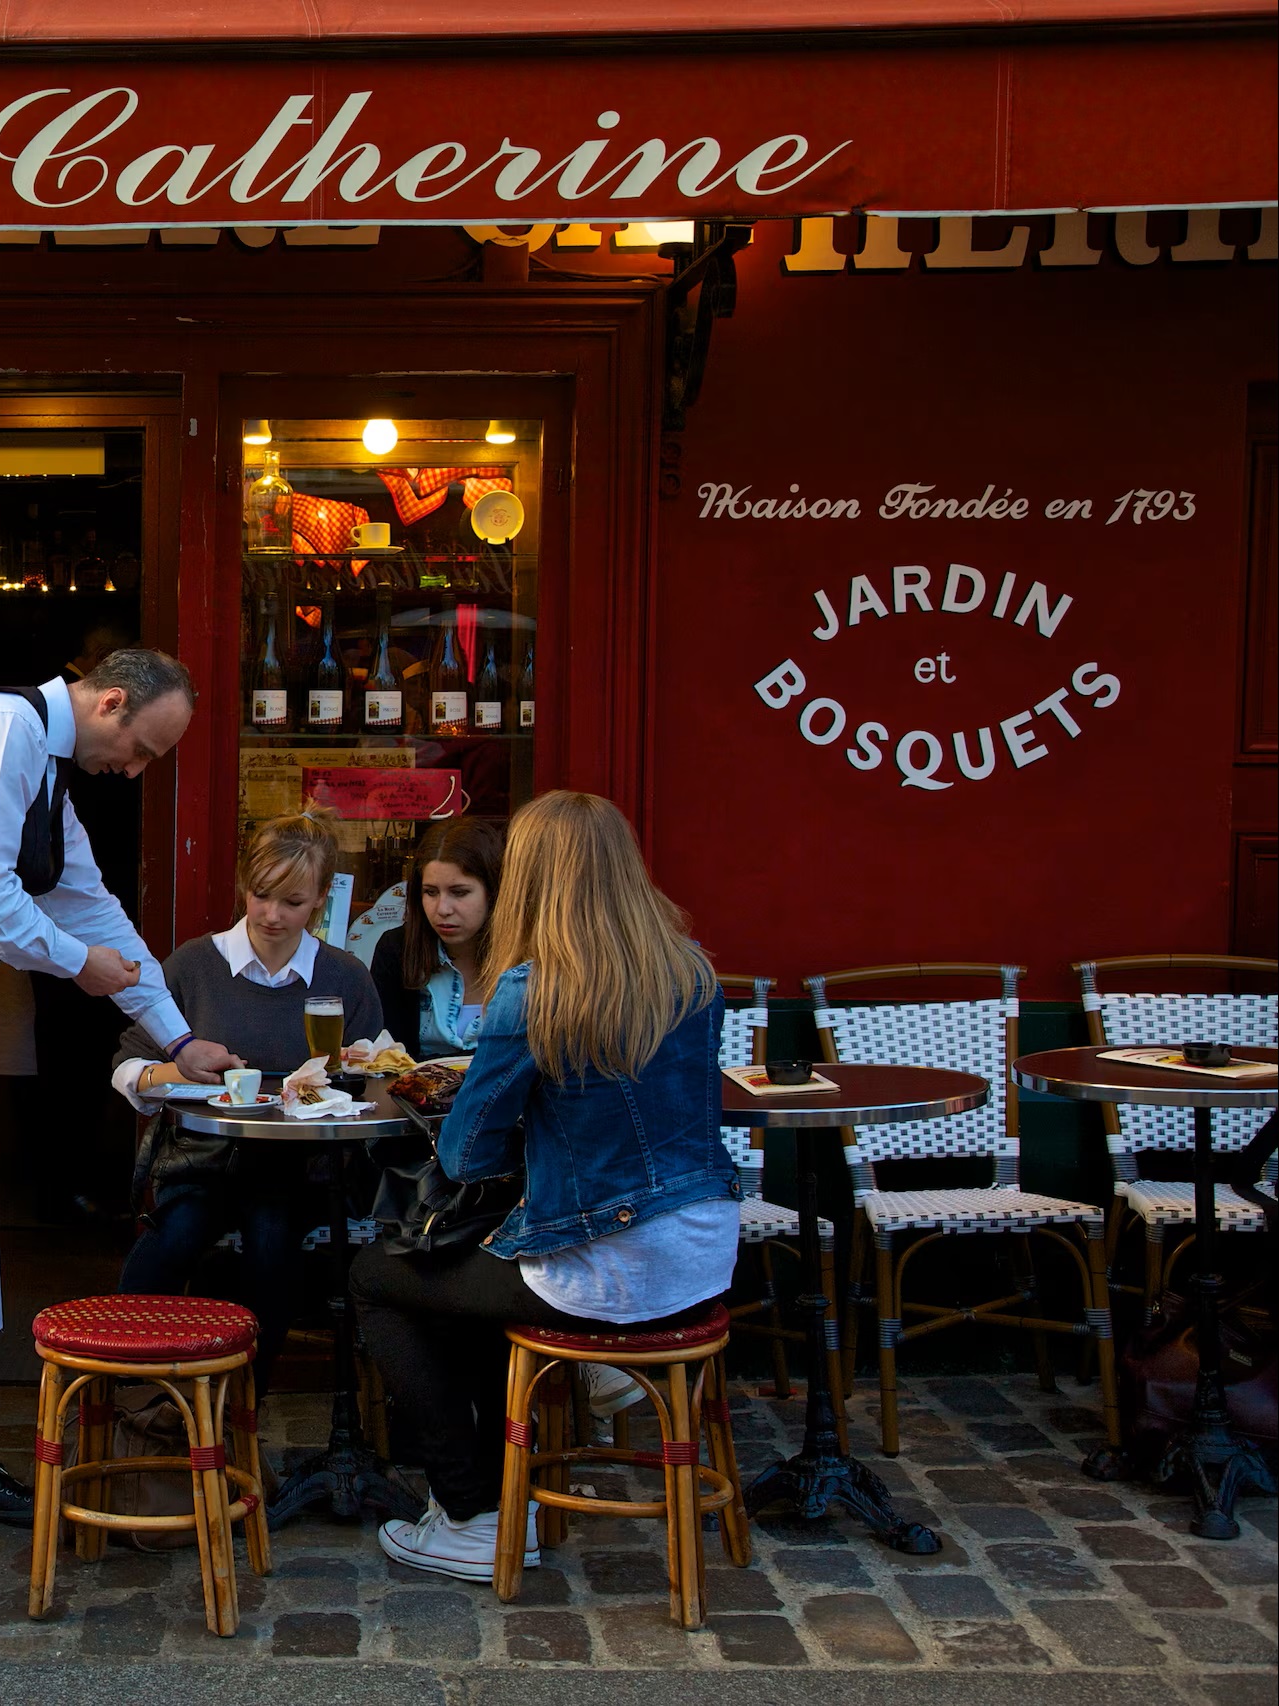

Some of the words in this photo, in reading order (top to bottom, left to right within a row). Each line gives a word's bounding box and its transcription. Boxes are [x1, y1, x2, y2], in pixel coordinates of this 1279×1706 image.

[697, 481, 861, 520] Maison
[878, 482, 1030, 520] Fondée
[1044, 500, 1093, 519] en
[1105, 489, 1197, 526] 1793
[812, 563, 1074, 641] JARDIN
[914, 651, 956, 684] et
[753, 658, 1121, 791] BOSQUETS
